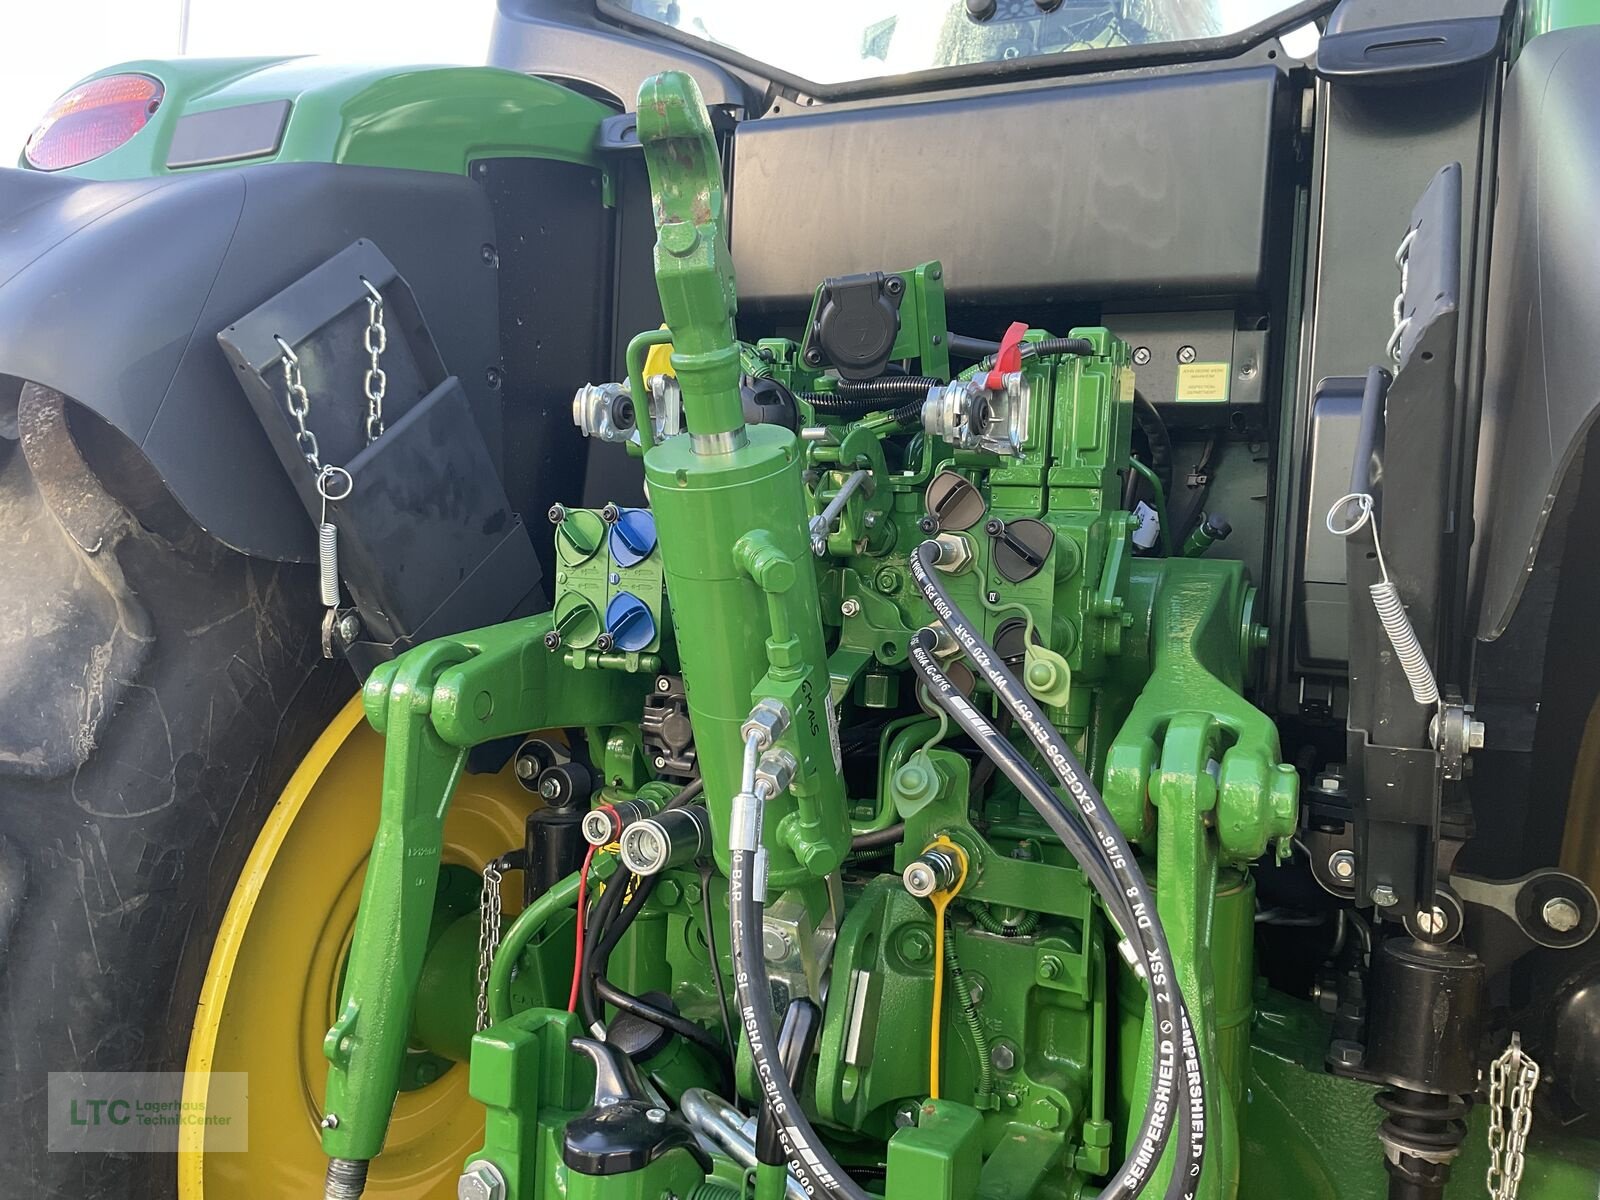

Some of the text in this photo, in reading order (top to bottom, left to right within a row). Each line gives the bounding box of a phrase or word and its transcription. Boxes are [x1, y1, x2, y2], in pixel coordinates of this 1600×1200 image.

[923, 583, 938, 601] PSI
[933, 597, 953, 620] 6090
[954, 623, 976, 648] BAR
[912, 647, 930, 667] MSHA
[924, 664, 951, 692] IC-8/16
[972, 647, 991, 667] 420
[988, 669, 1008, 690] WP
[1011, 699, 1034, 721] 857
[1030, 721, 1050, 744] EN
[1046, 744, 1097, 816] EXCEEDS
[732, 869, 743, 902] BAR
[1126, 886, 1139, 898] 8
[1133, 902, 1152, 929] DN
[1146, 947, 1167, 985] SSK
[1157, 992, 1170, 1003] 2
[742, 1005, 763, 1055] MSHA
[758, 1058, 787, 1115] IC-8/16
[1124, 1039, 1174, 1190] SEMPERSHIELD
[776, 1128, 815, 1196] 6090 PSI
